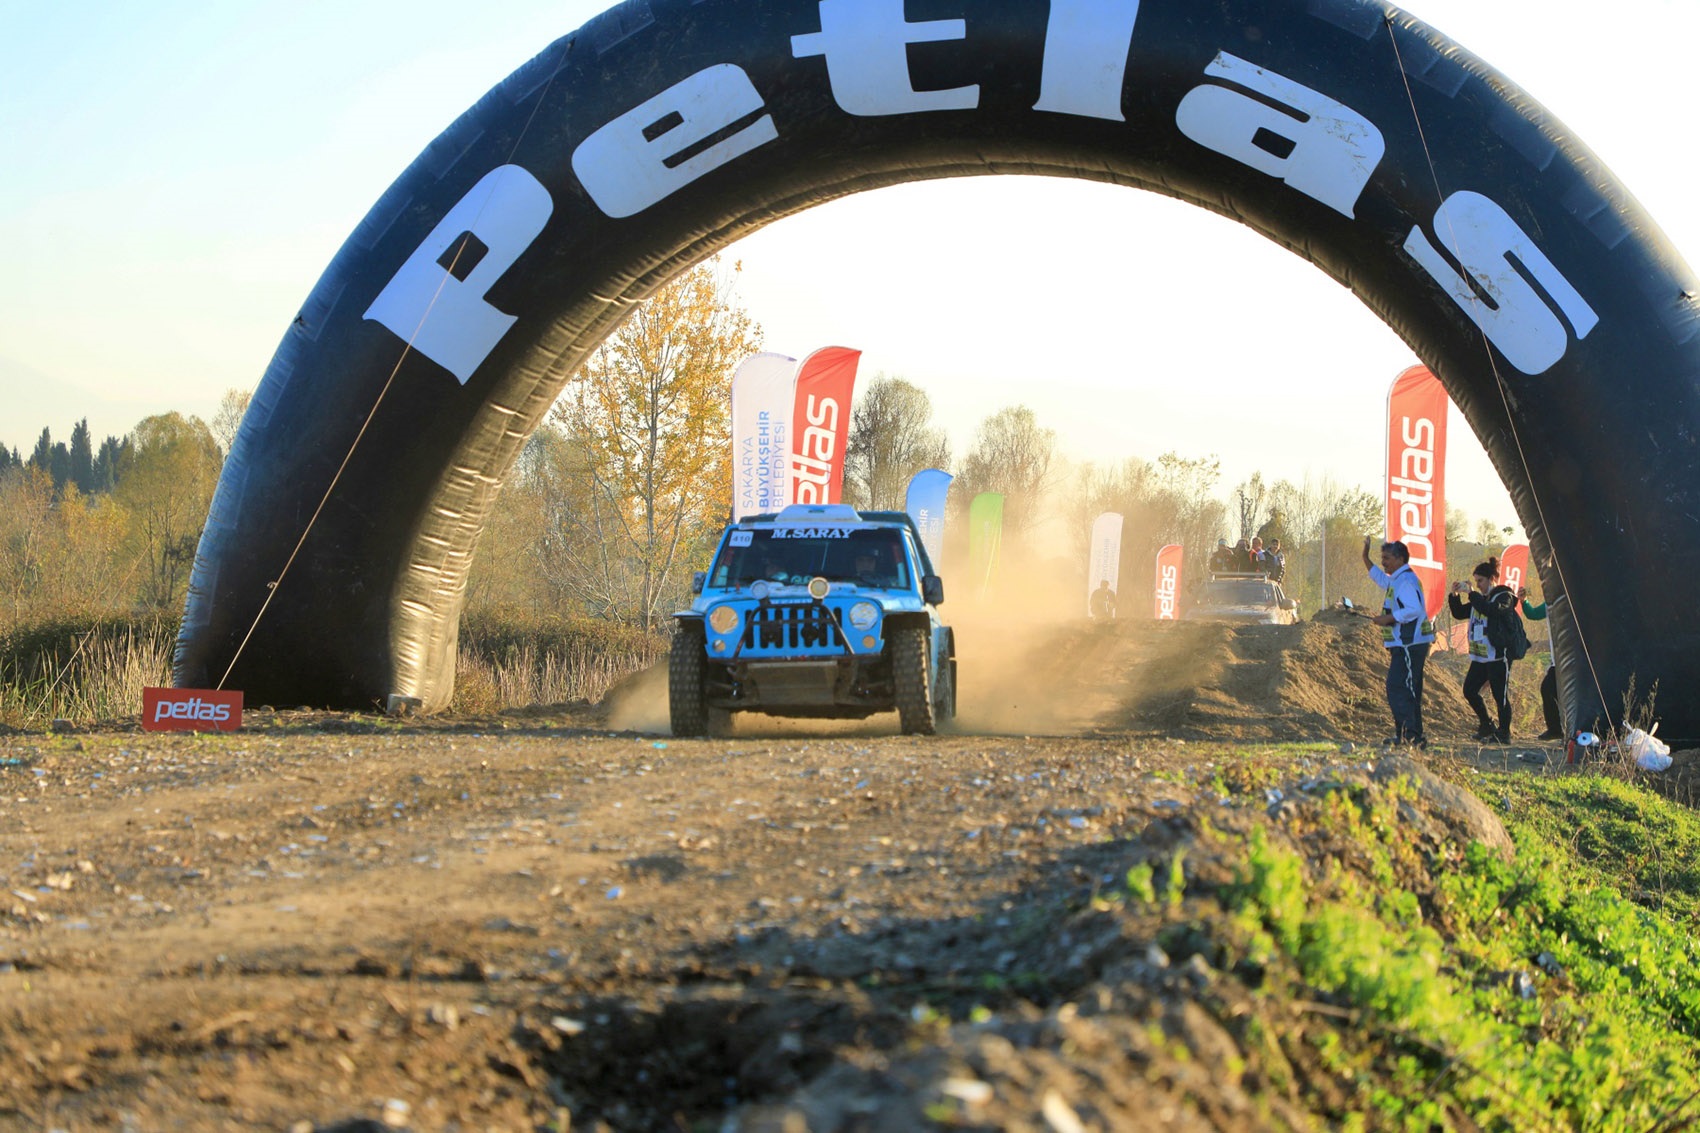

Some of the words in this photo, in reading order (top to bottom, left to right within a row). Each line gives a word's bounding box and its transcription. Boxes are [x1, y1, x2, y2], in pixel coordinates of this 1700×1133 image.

[743, 437, 754, 509] SAKARYA
[756, 411, 771, 508] BÜYÜKŞEHİR
[772, 421, 785, 508] BELEDİYESİ
[792, 394, 839, 505] etlas
[1391, 416, 1443, 570] petlas
[771, 528, 855, 539] M.SARAY
[154, 697, 231, 723] petlas
